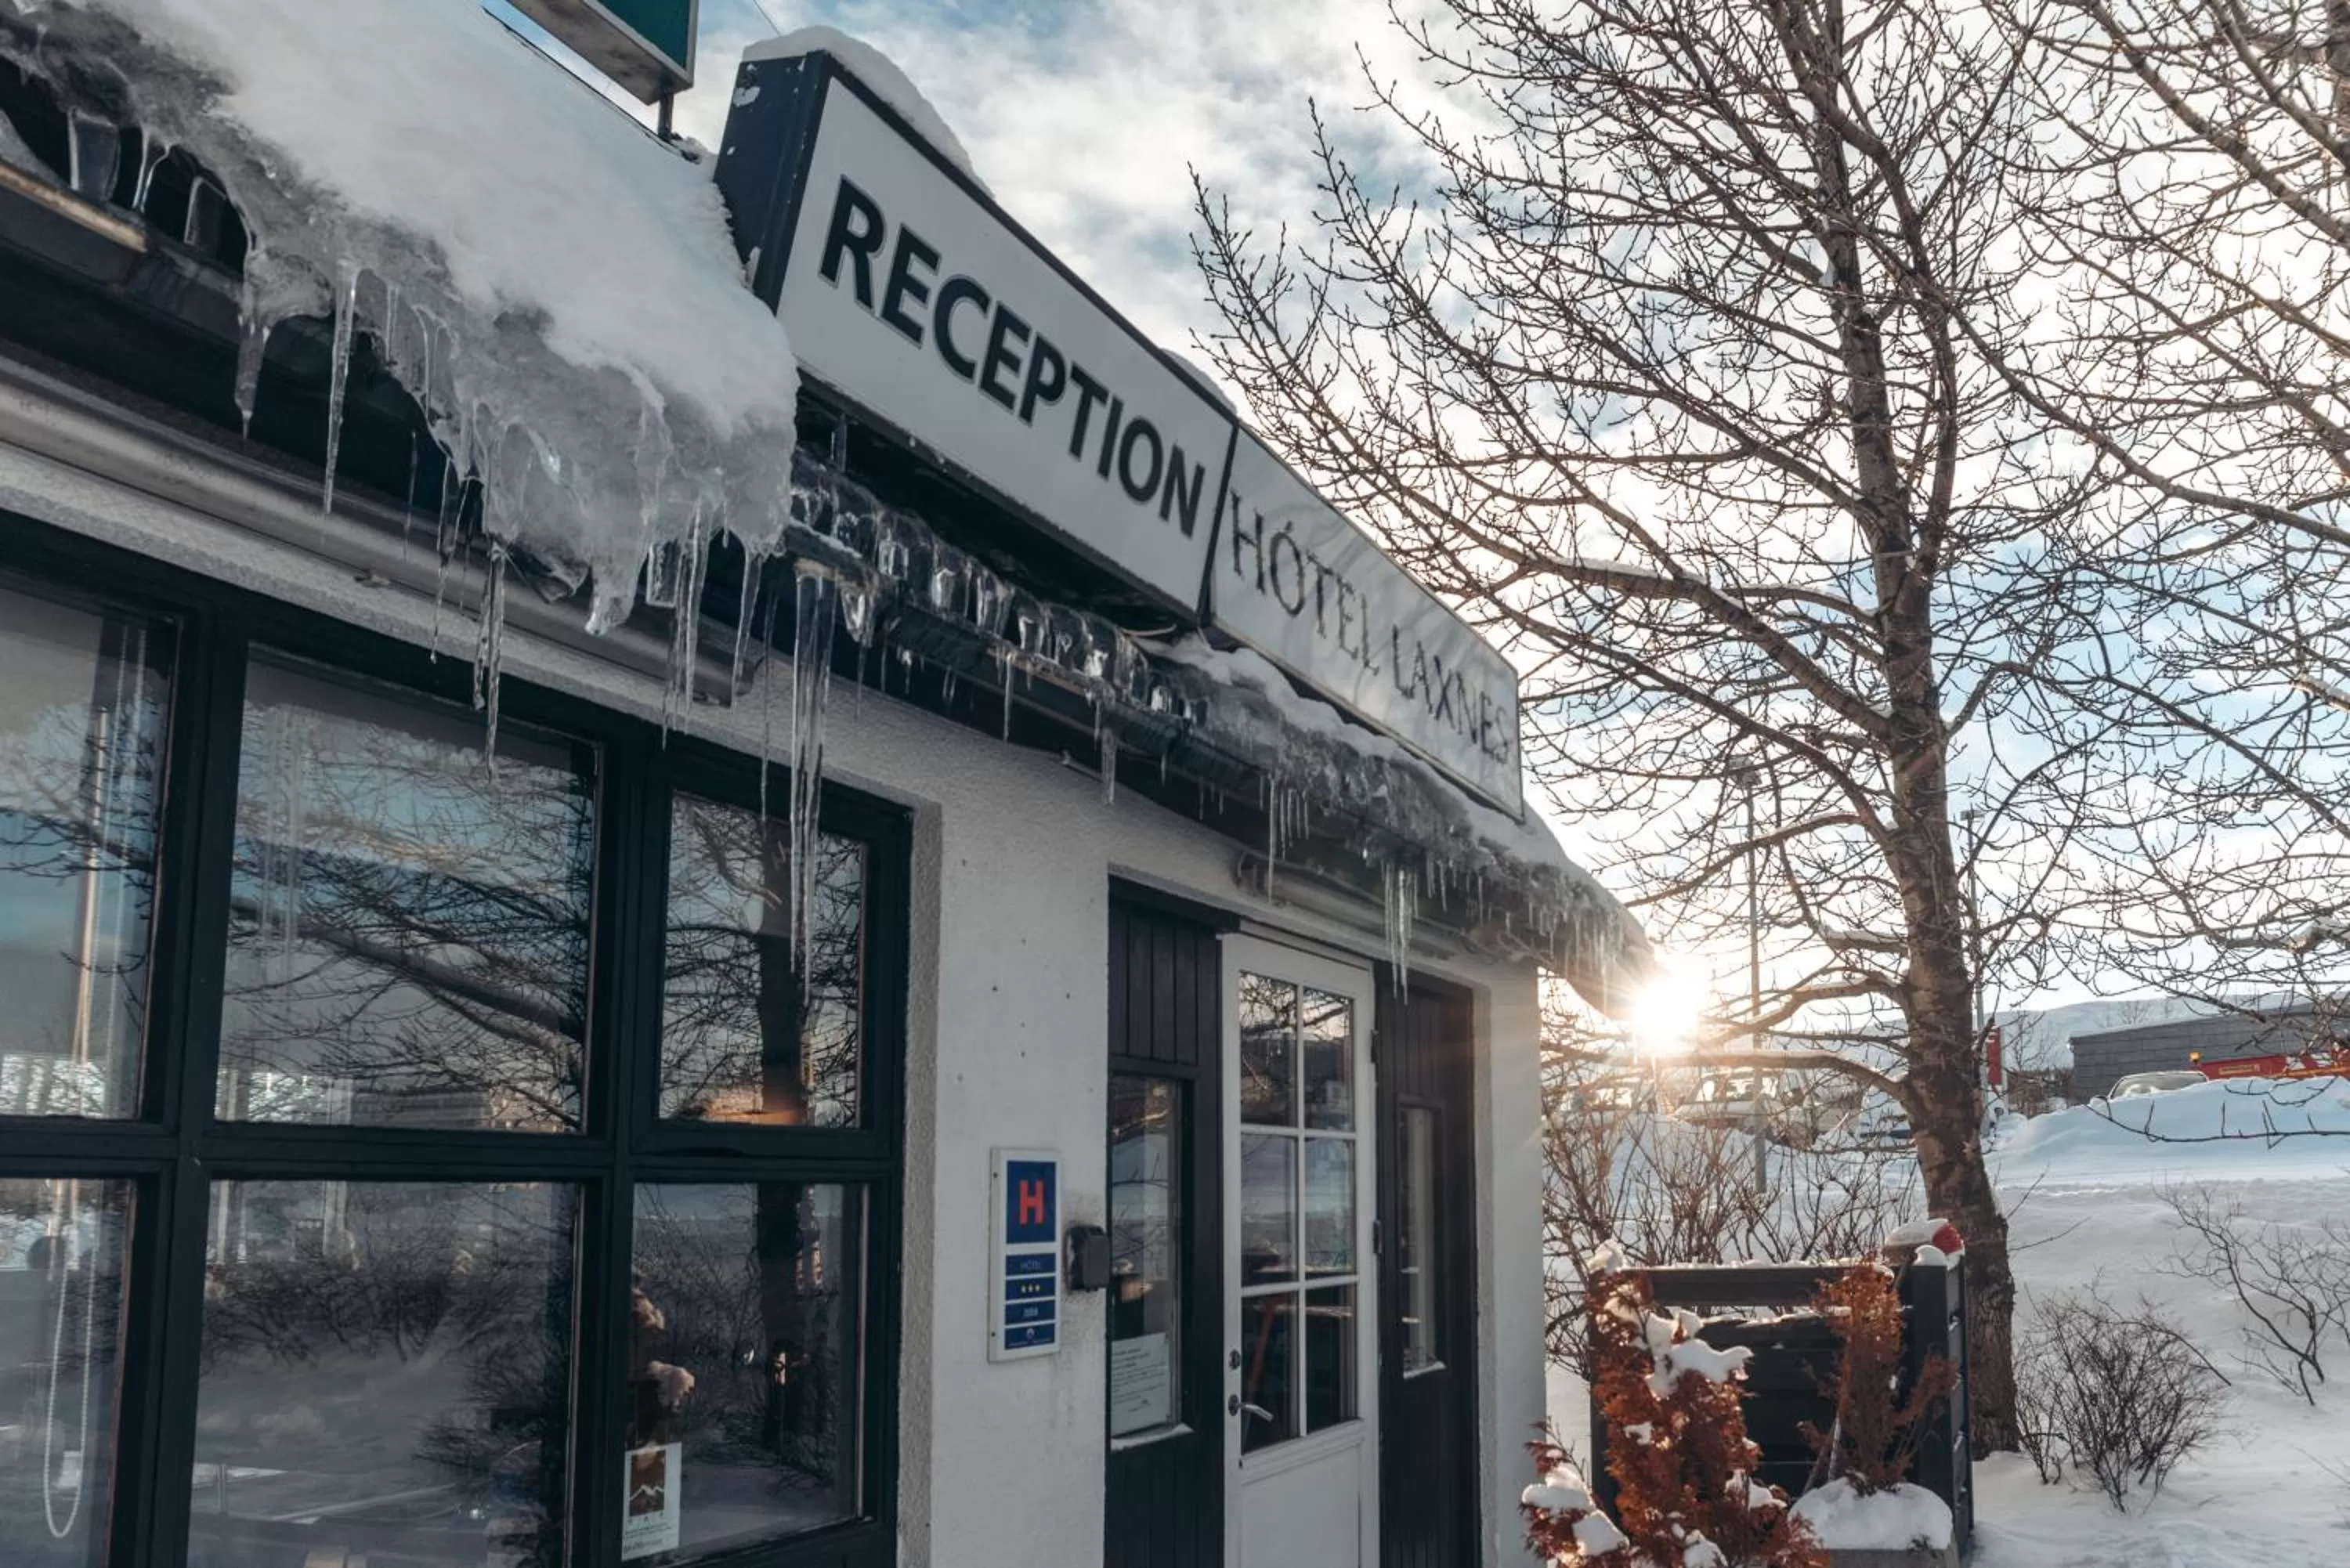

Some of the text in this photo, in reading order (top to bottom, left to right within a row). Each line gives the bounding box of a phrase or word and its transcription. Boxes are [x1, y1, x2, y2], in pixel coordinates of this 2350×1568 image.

[820, 174, 1204, 538] RECEPTION
[1231, 487, 1509, 765] HÓTEL LAXNES
[1019, 1180, 1044, 1225] H
